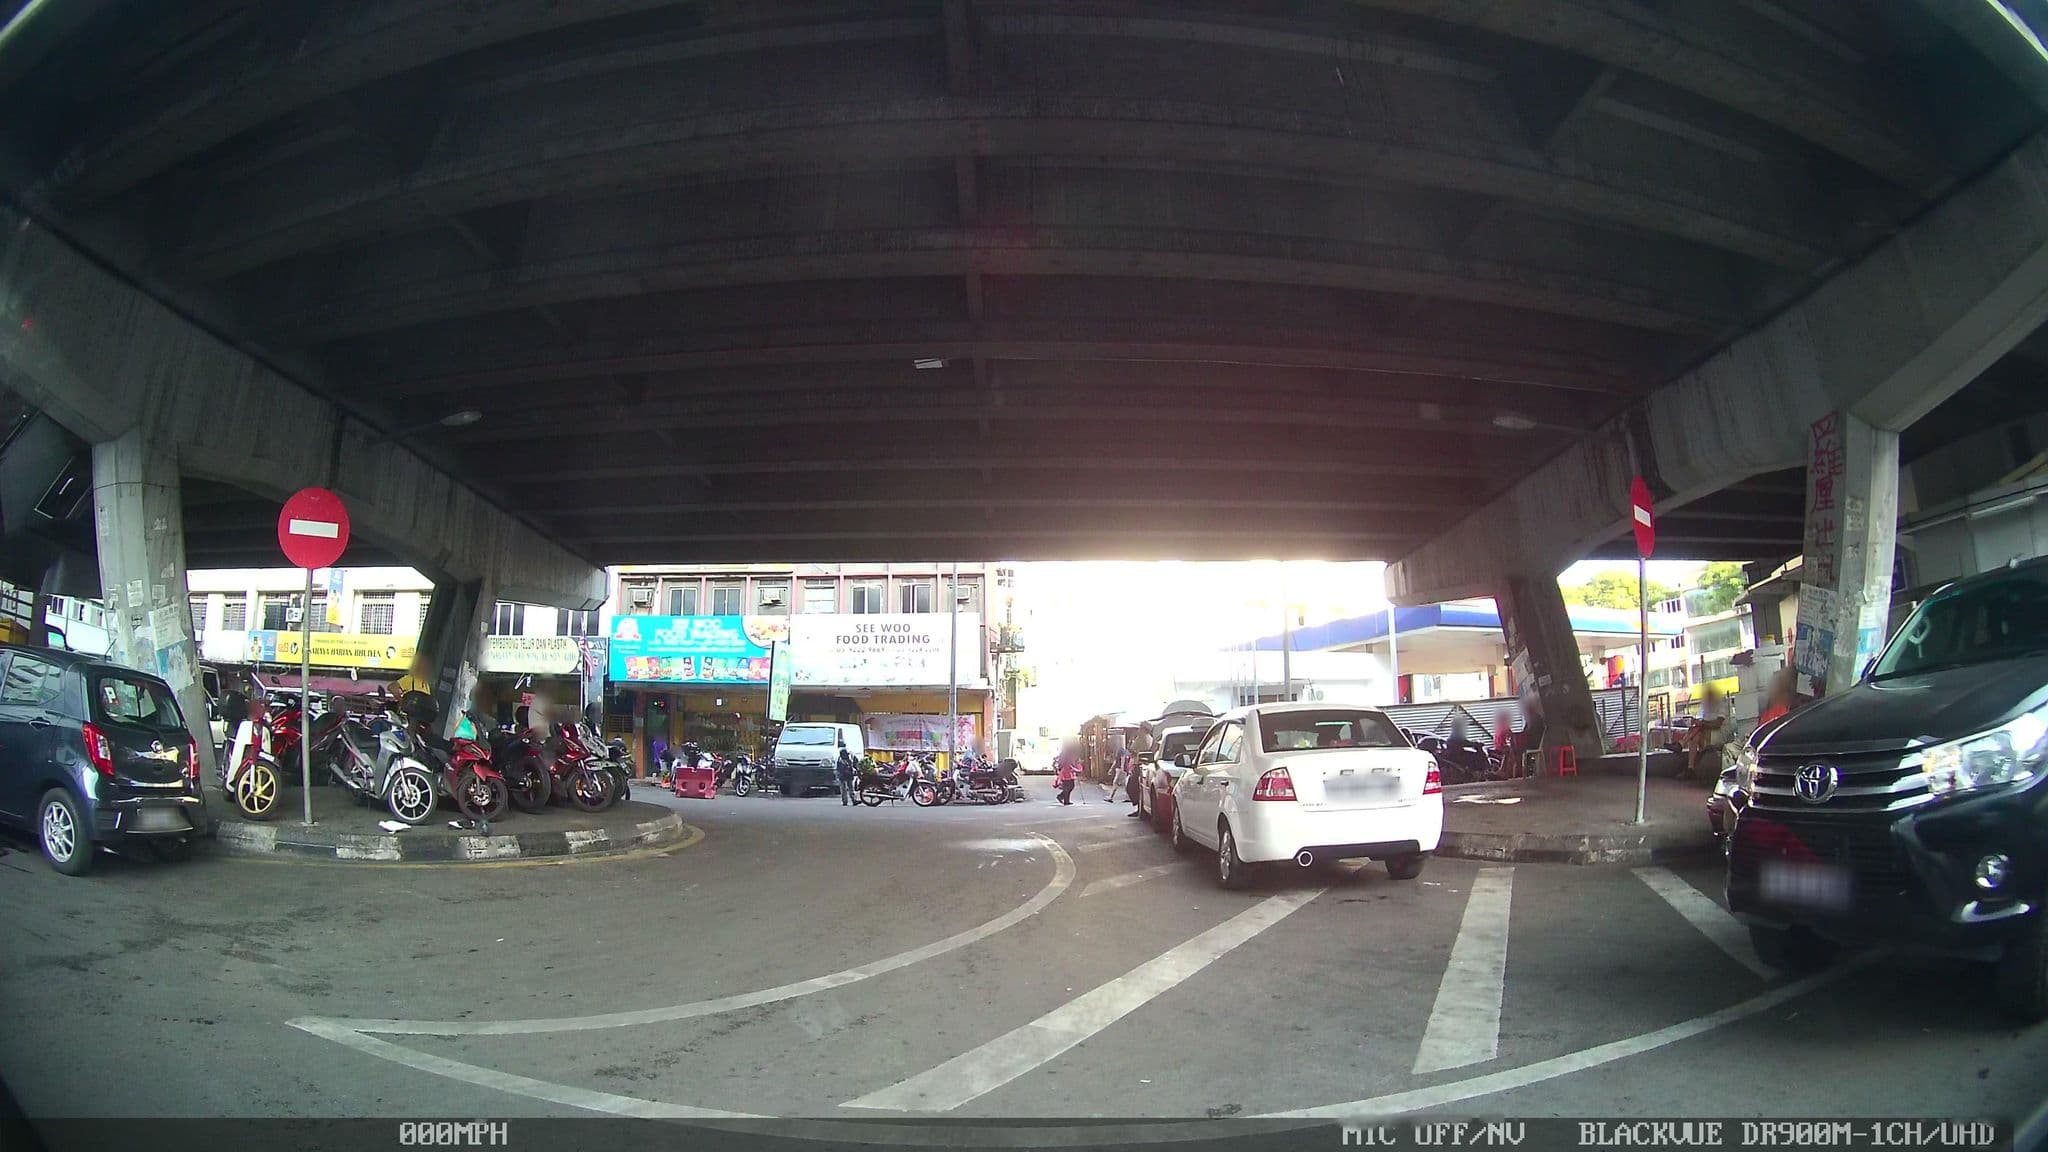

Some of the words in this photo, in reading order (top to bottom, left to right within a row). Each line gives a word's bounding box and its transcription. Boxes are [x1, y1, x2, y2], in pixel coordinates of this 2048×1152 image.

[855, 623, 876, 633] SEE
[881, 623, 911, 633] WOO
[836, 635, 869, 645] FOOD
[873, 634, 930, 645] TRADING
